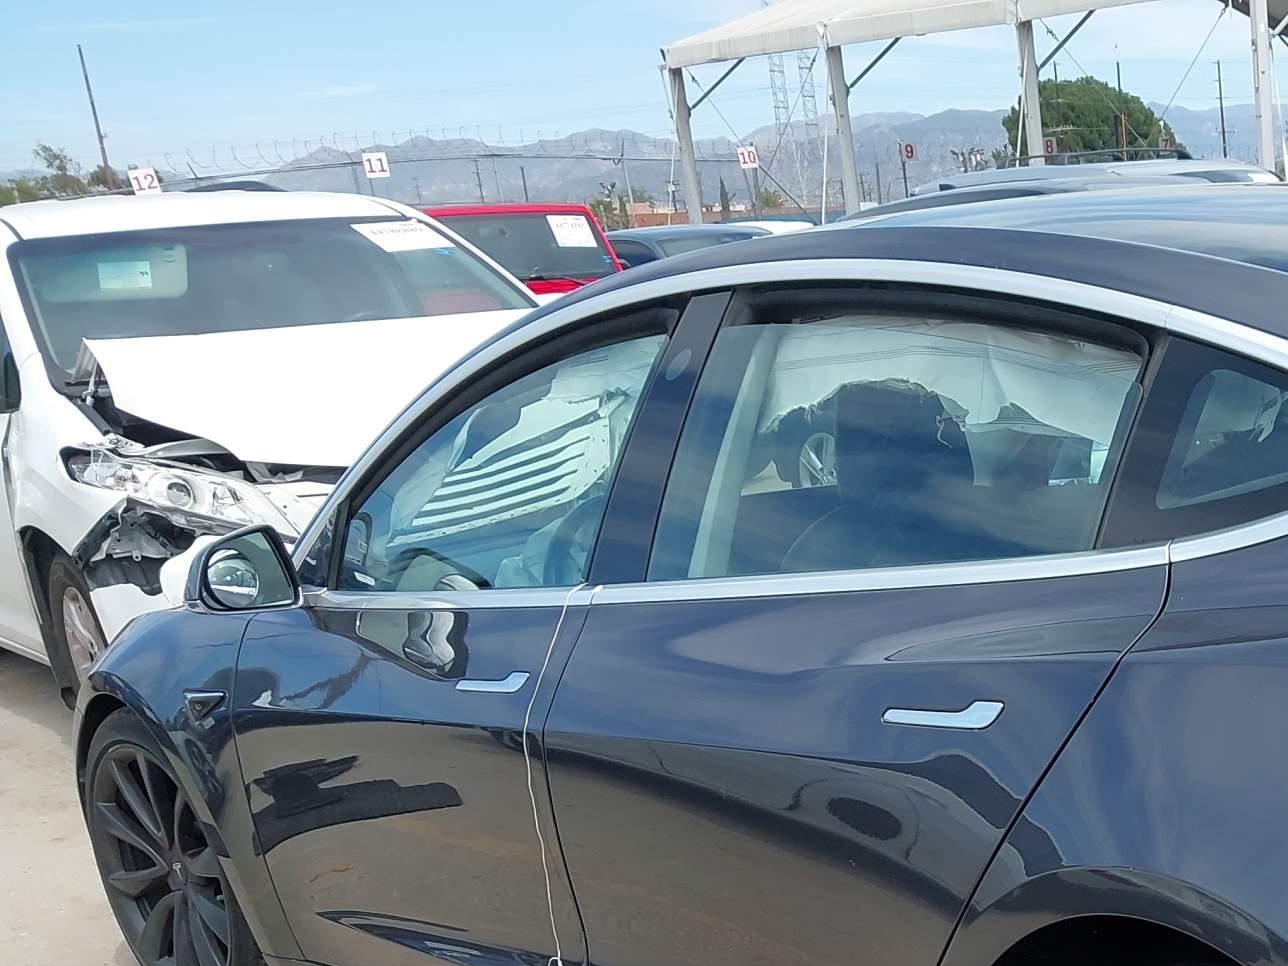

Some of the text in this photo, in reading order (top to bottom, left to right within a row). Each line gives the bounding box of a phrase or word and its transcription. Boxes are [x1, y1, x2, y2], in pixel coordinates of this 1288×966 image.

[904, 143, 914, 160] 9
[1045, 138, 1054, 154] 8
[365, 158, 388, 173] 11
[739, 150, 757, 165] 10
[132, 173, 158, 192] 12
